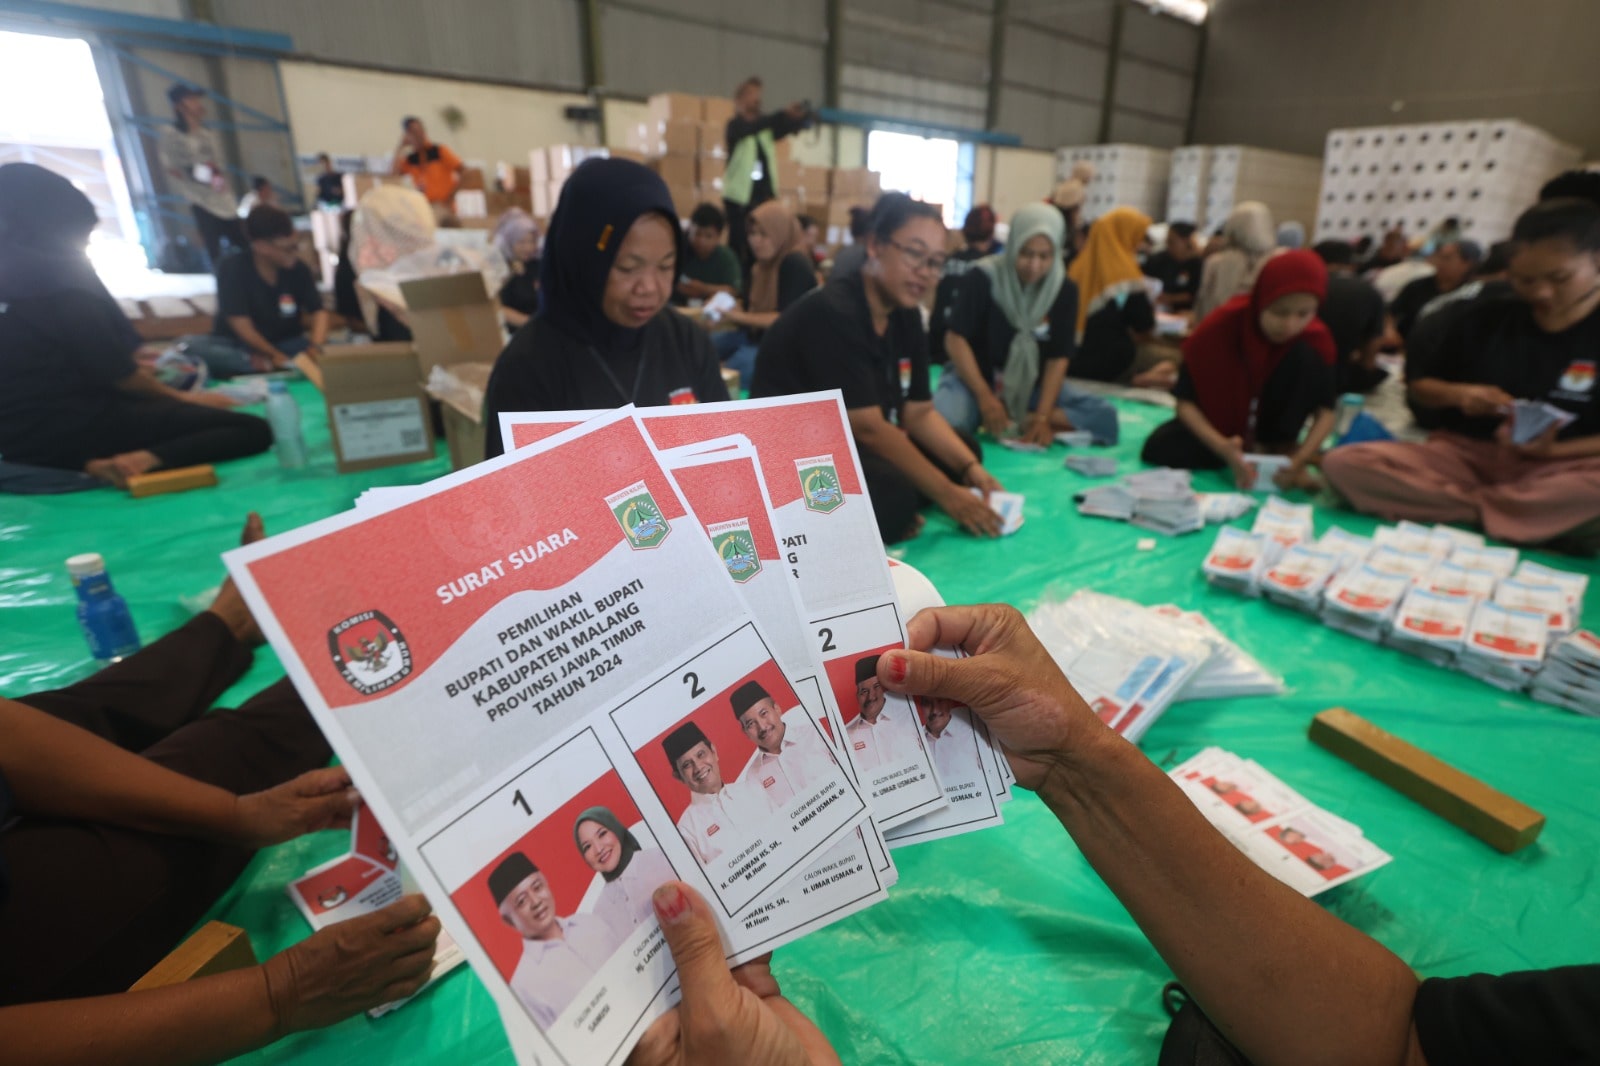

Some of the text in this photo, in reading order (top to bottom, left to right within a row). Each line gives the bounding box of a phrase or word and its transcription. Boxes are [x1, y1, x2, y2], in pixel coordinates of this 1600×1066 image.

[436, 528, 579, 604] SURAT SUARA
[333, 611, 375, 634] KOMISI
[497, 591, 583, 645] PEMILIHAN
[444, 578, 644, 698] BUPATI DAN WAKIL BUPATI
[818, 628, 837, 652] 2
[472, 602, 640, 707] KABUPATEN MALANG
[486, 620, 646, 722] PROVINSI JAWA TIMUR
[532, 653, 623, 716] TAHUN 2024
[682, 671, 706, 699] 2
[879, 784, 897, 796] UMAR
[919, 772, 926, 780] dr
[512, 789, 533, 816] 1
[790, 781, 837, 819] CALON WAKIL BUPATI
[792, 788, 845, 832] H. UMAR USMAN, dr
[720, 882, 729, 890] H.
[728, 855, 760, 884] GUNAWAN
[759, 848, 771, 859] HS,
[728, 839, 762, 869] CALON BUPATI
[804, 854, 856, 881] CALON WAKIL BUPATI
[745, 861, 767, 881] M.Hum
[802, 887, 811, 895] H.
[810, 878, 831, 892] UMAR
[856, 864, 863, 872] dr
[745, 915, 769, 930] M.Hum
